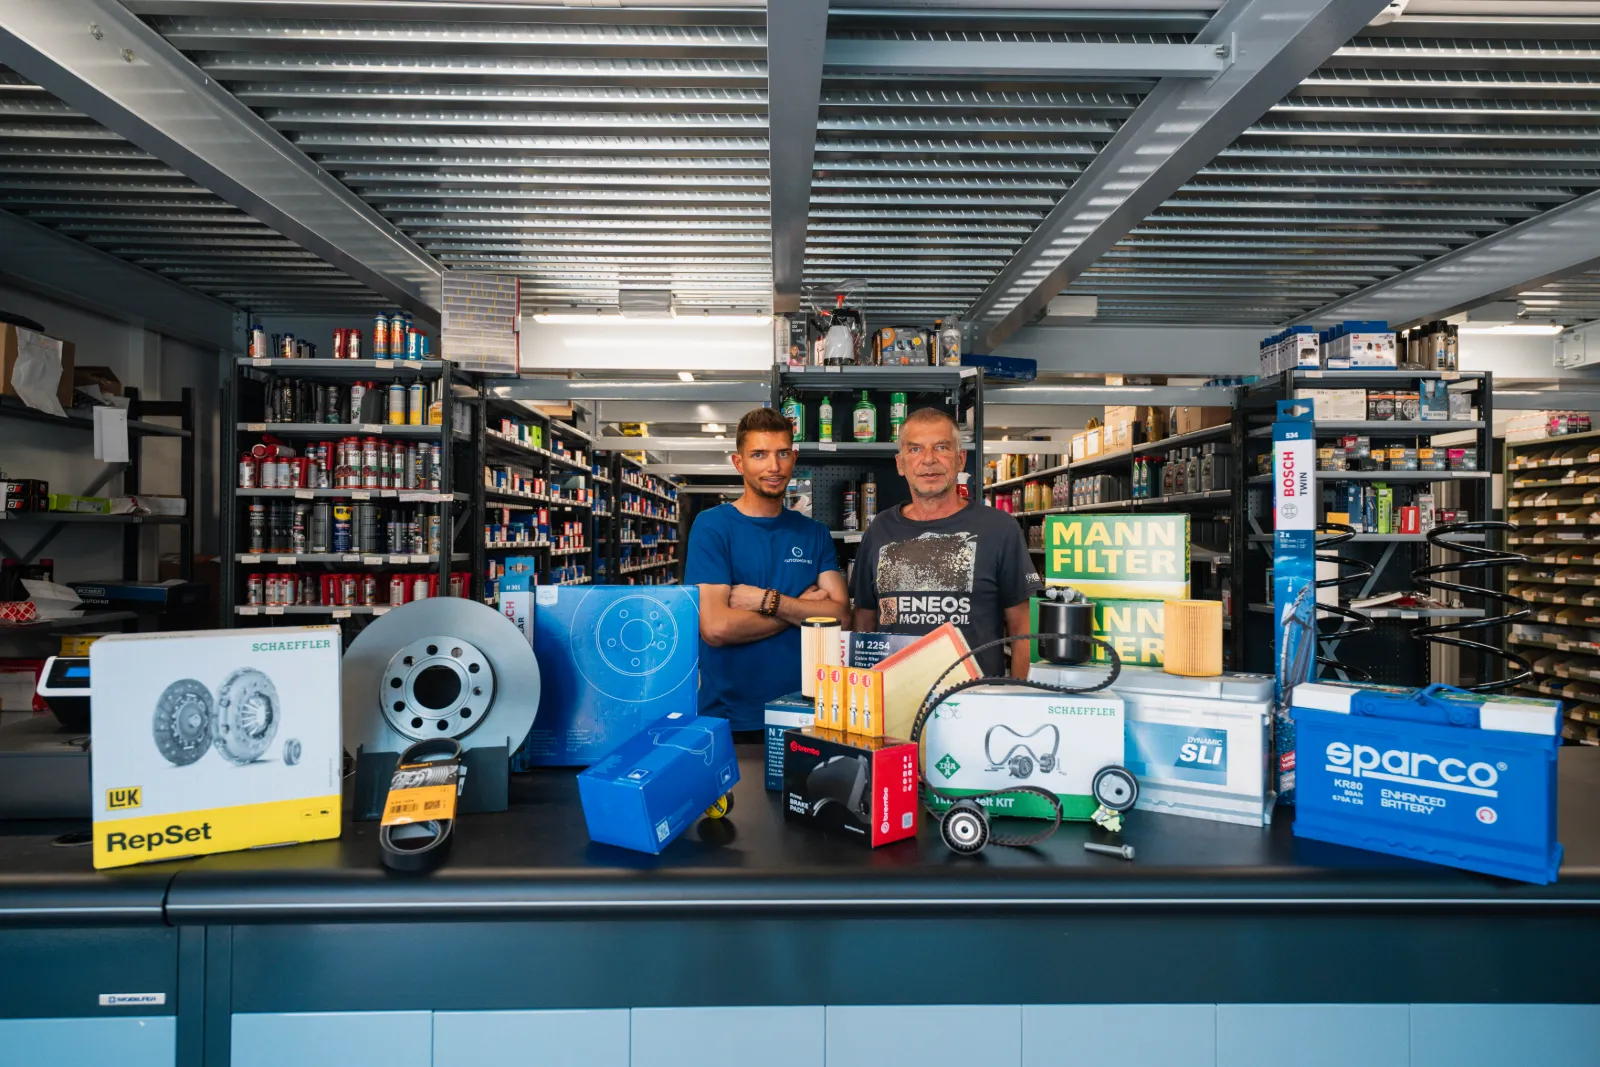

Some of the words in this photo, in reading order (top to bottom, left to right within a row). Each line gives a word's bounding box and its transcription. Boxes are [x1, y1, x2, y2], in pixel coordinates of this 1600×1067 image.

[1283, 451, 1295, 497] BOSCH
[1300, 472, 1308, 496] TWIN
[1053, 522, 1176, 546] MANN
[1053, 549, 1177, 574] FILTER
[898, 596, 971, 614] ENEOS
[899, 613, 946, 625] MOTOR
[949, 614, 971, 625] OIL
[252, 639, 331, 652] SCHAEFFLER
[855, 640, 865, 649] M
[866, 640, 891, 650] 2254
[1048, 706, 1117, 717] SCHAEFFLER
[768, 727, 776, 737] N
[1187, 736, 1223, 746] DYNAMIC
[797, 744, 820, 756] brembo
[1179, 744, 1223, 765] SLI
[1326, 741, 1498, 788] sparco
[1334, 778, 1363, 791] KR80
[1344, 789, 1363, 798] 80Ah
[1381, 788, 1446, 807] ENHANCED
[789, 798, 809, 810] BRAKE
[975, 796, 993, 807] elt
[995, 797, 1015, 808] KIT
[1352, 797, 1364, 806] EN
[1381, 798, 1434, 815] BATTERY
[789, 804, 805, 815] PADS
[106, 822, 212, 852] RepSet
